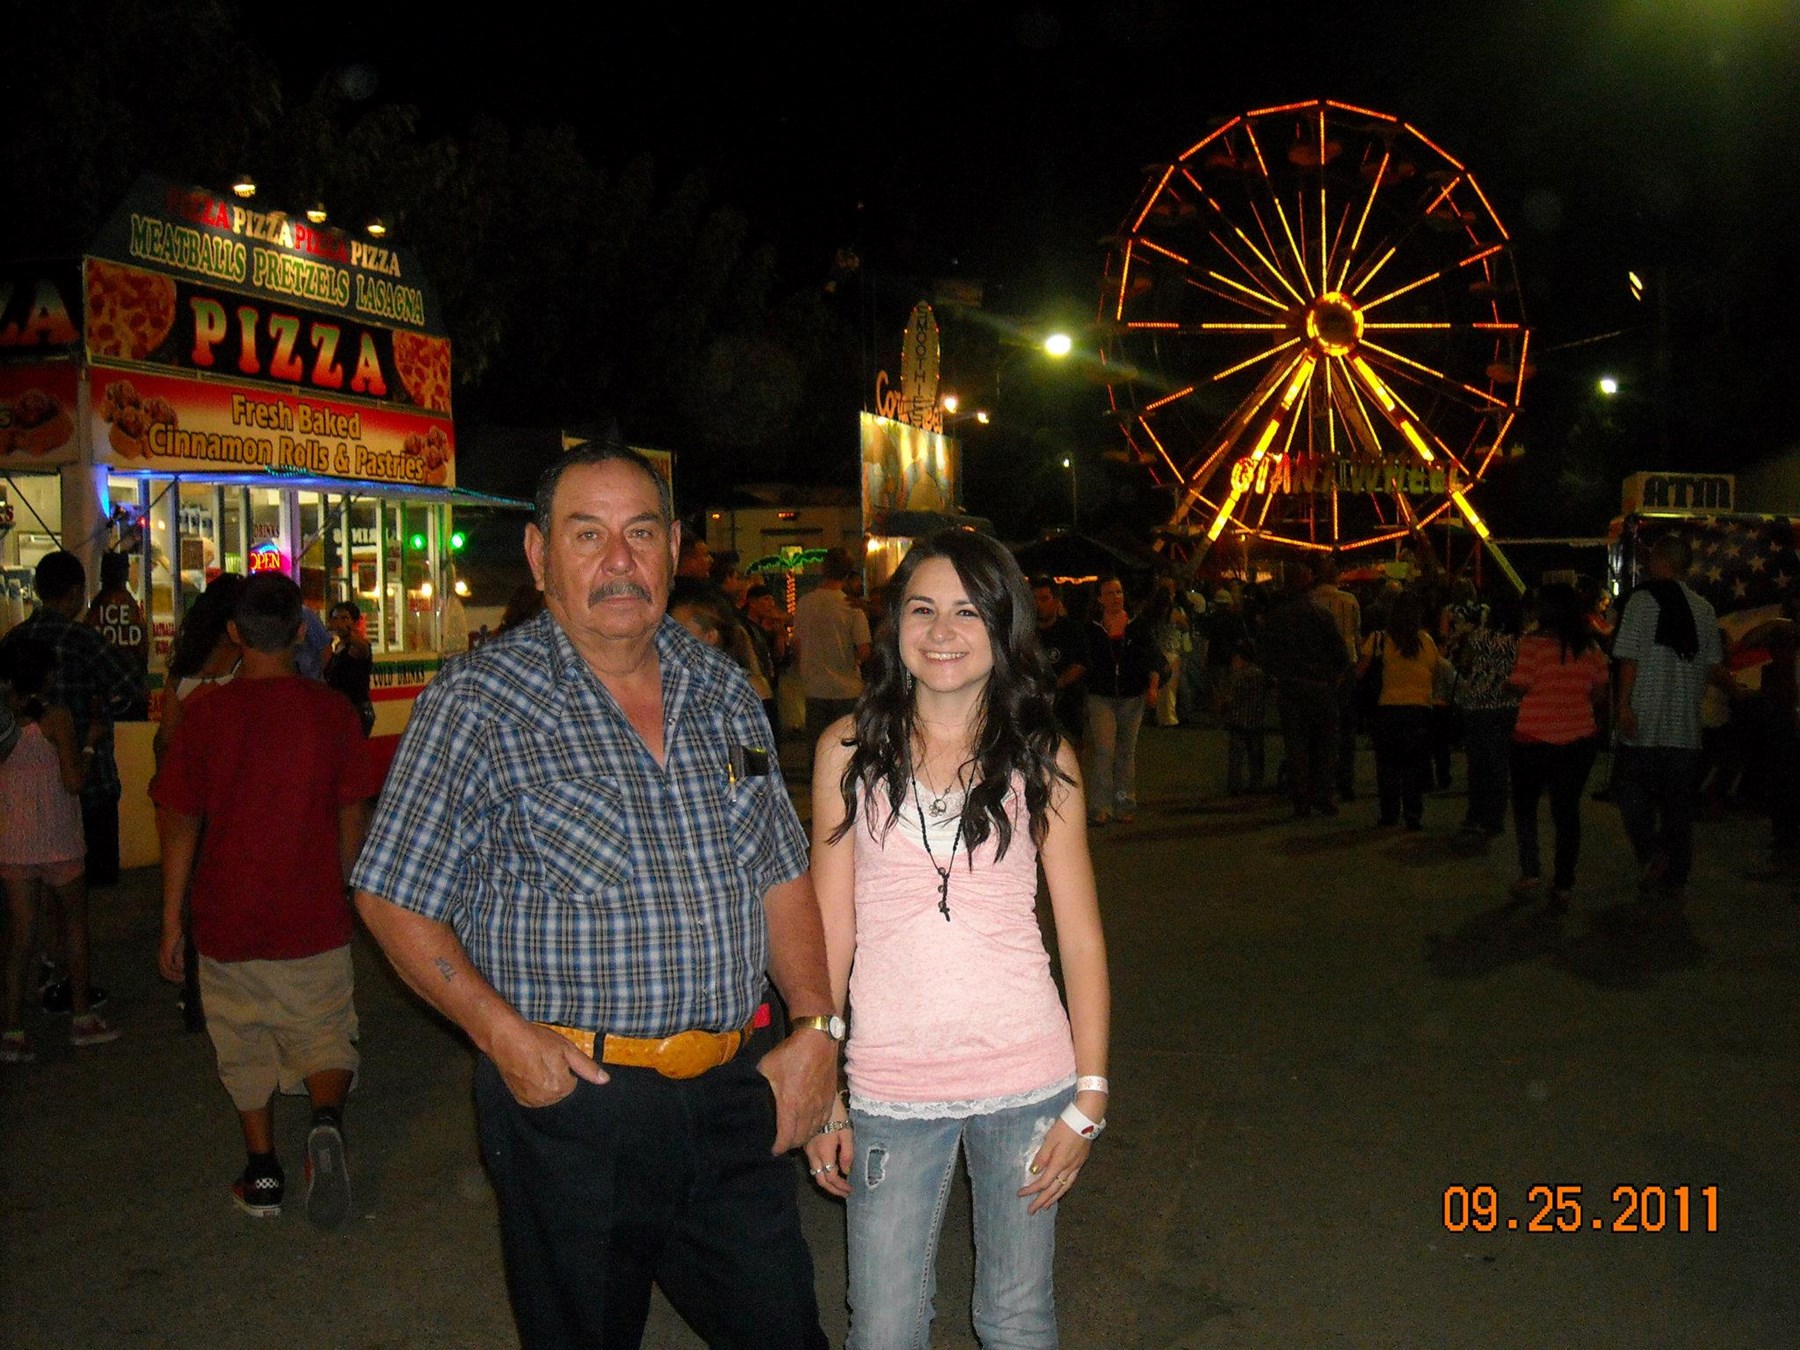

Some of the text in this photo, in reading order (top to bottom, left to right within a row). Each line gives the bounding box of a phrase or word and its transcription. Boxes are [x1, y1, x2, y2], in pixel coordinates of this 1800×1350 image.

[232, 205, 294, 250] PIZZA
[295, 223, 348, 263] PIZZA
[351, 239, 401, 278] PIZZA
[130, 213, 425, 326] MEATBALLS PRETZELS LASAGNA
[190, 296, 388, 397] PIZZA
[231, 394, 362, 441] Fresh Baked
[149, 421, 426, 482] Cinnamon Rolls & Pastries
[1643, 476, 1732, 509] ATM
[250, 552, 281, 570] OPEN
[96, 625, 142, 647] OLD
[100, 604, 130, 625] ICE
